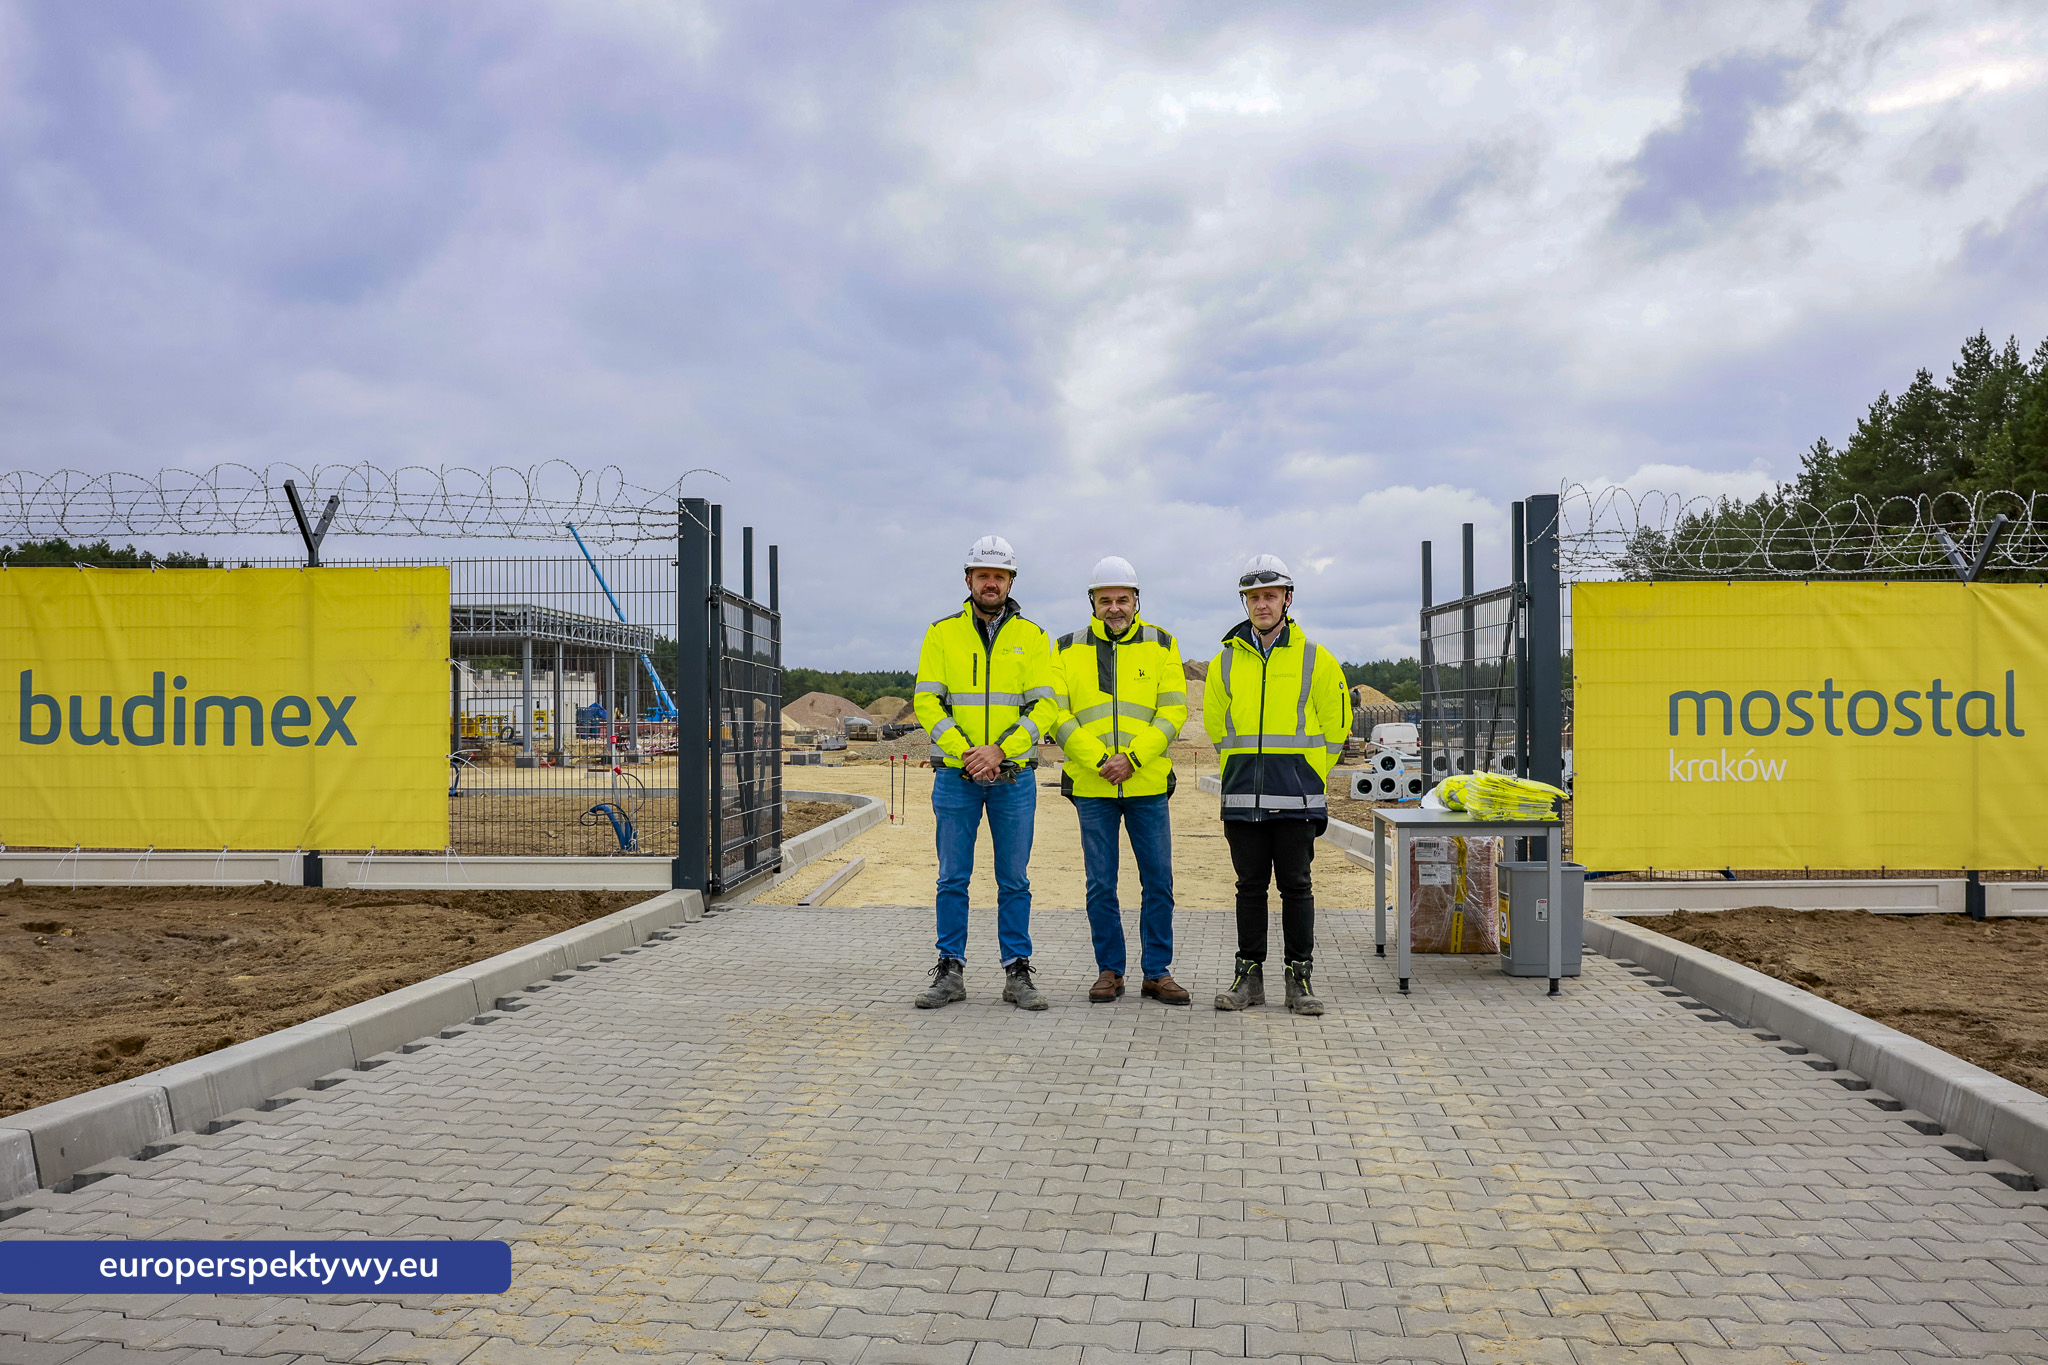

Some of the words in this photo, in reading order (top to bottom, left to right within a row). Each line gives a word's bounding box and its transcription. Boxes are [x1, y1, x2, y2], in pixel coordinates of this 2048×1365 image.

[981, 549, 1006, 557] budimex
[19, 669, 357, 748] budimex
[1668, 669, 2026, 738] mostostal
[1669, 748, 1788, 782] kraków
